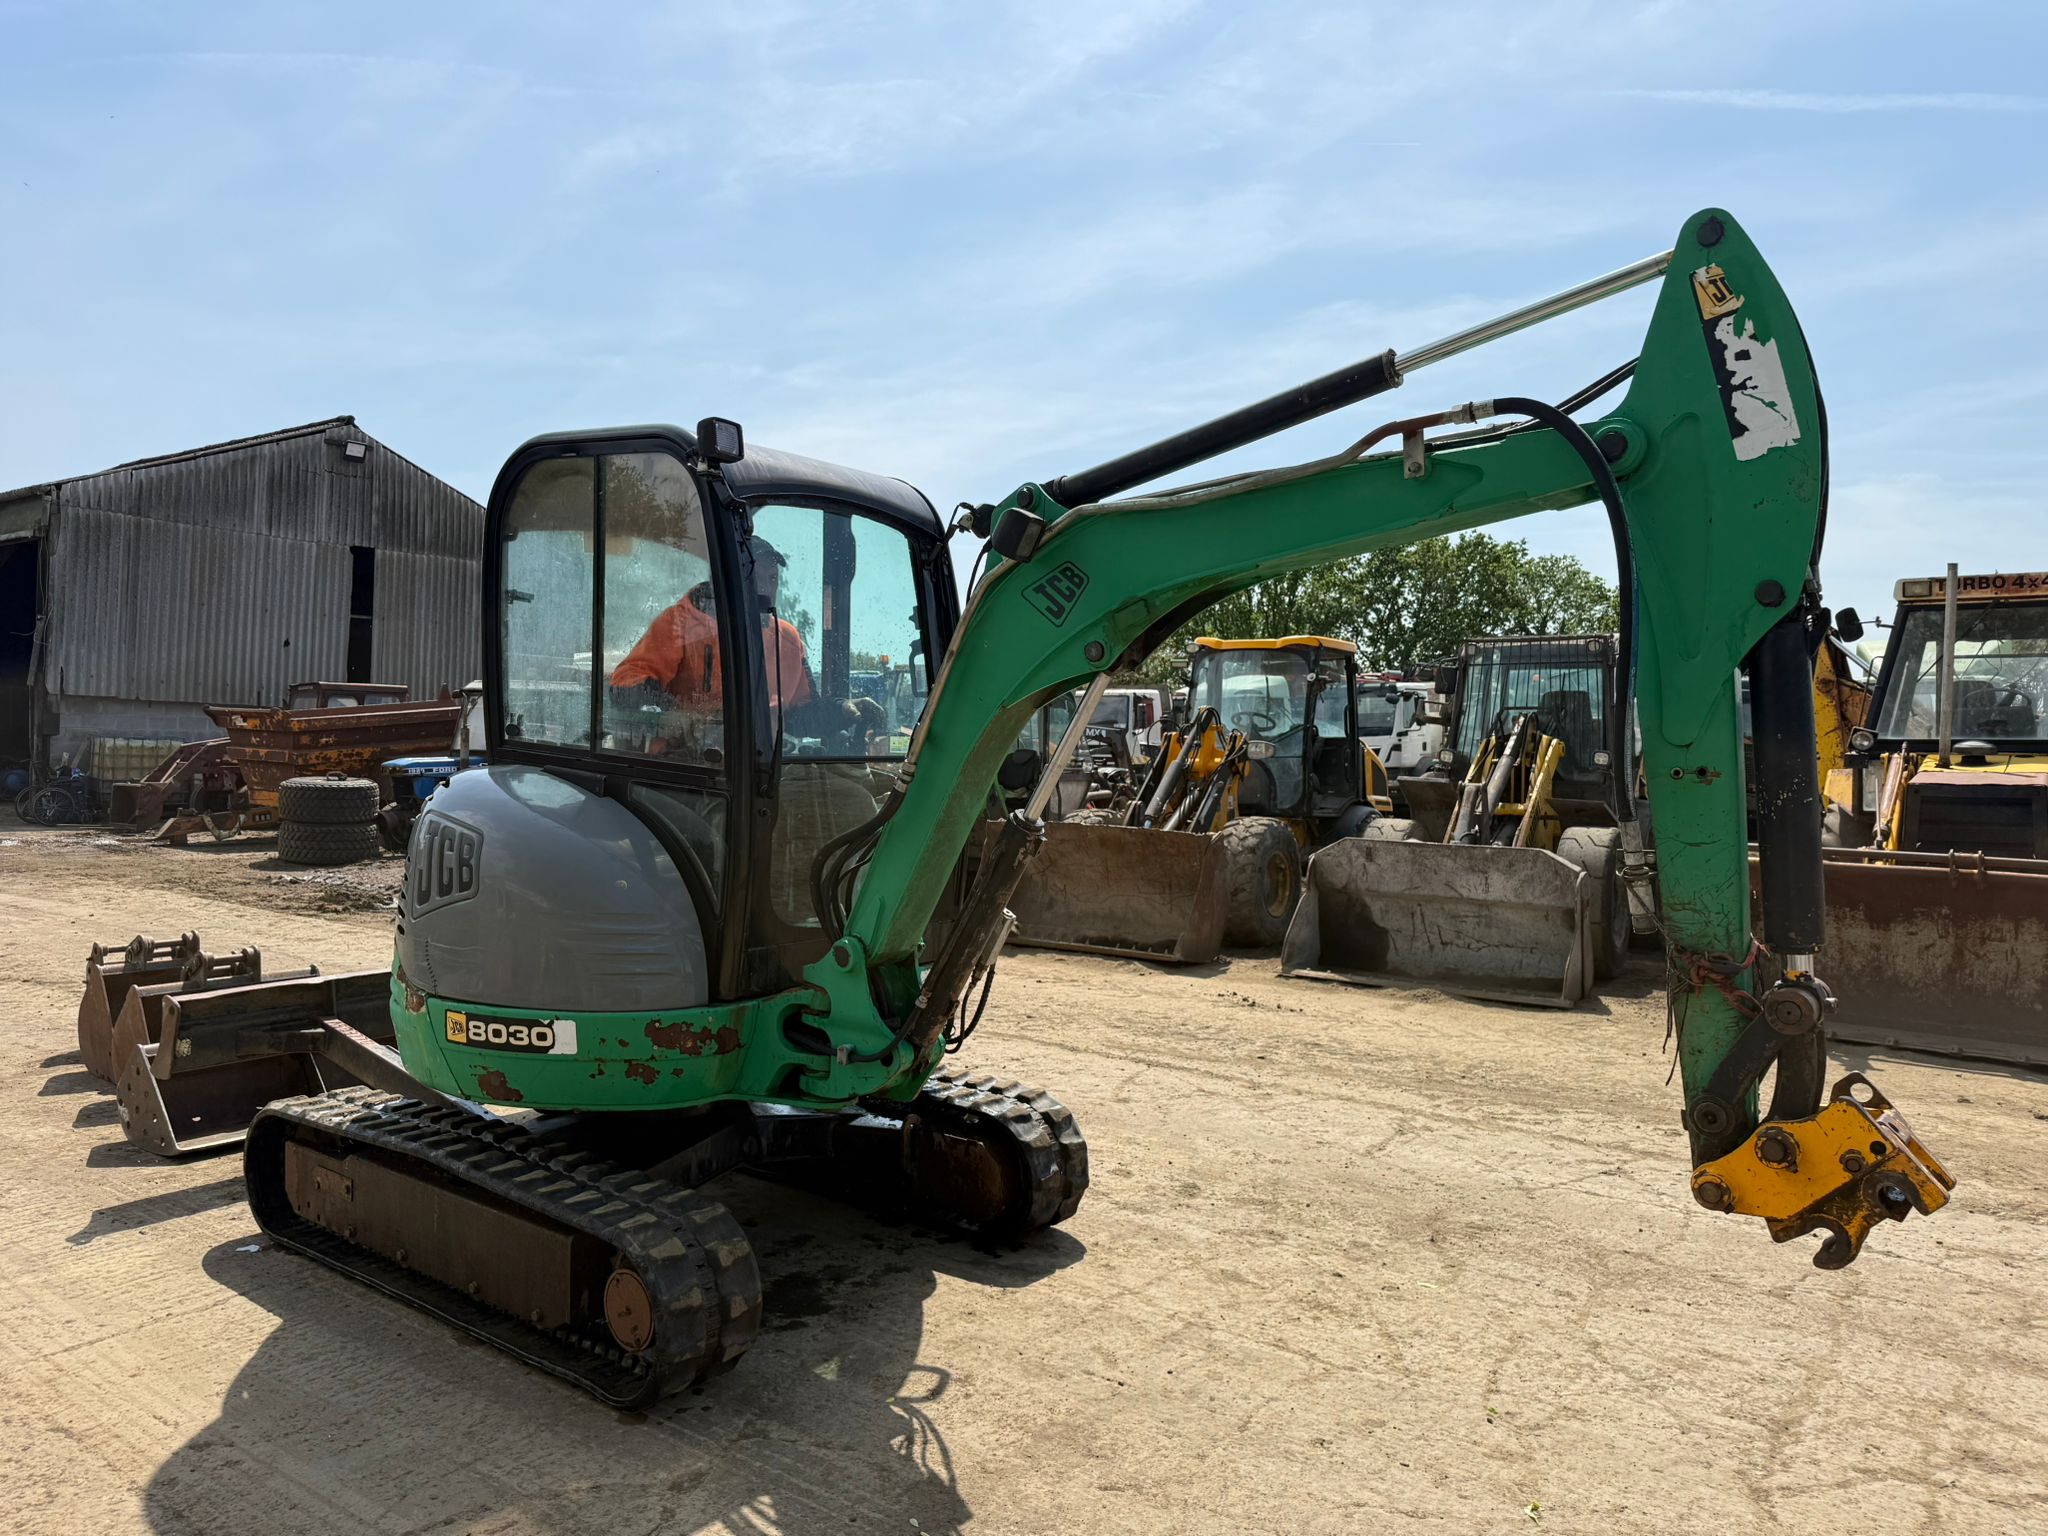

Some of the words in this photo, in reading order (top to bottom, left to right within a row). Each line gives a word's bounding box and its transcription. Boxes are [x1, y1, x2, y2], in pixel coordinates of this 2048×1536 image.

[1032, 566, 1085, 620] JCB
[1934, 576, 2006, 592] TRBO
[1085, 728, 1101, 737] MX
[432, 766, 457, 774] FORD
[417, 820, 475, 906] JCB
[451, 1019, 464, 1034] JCB
[468, 1020, 554, 1047] 8030
